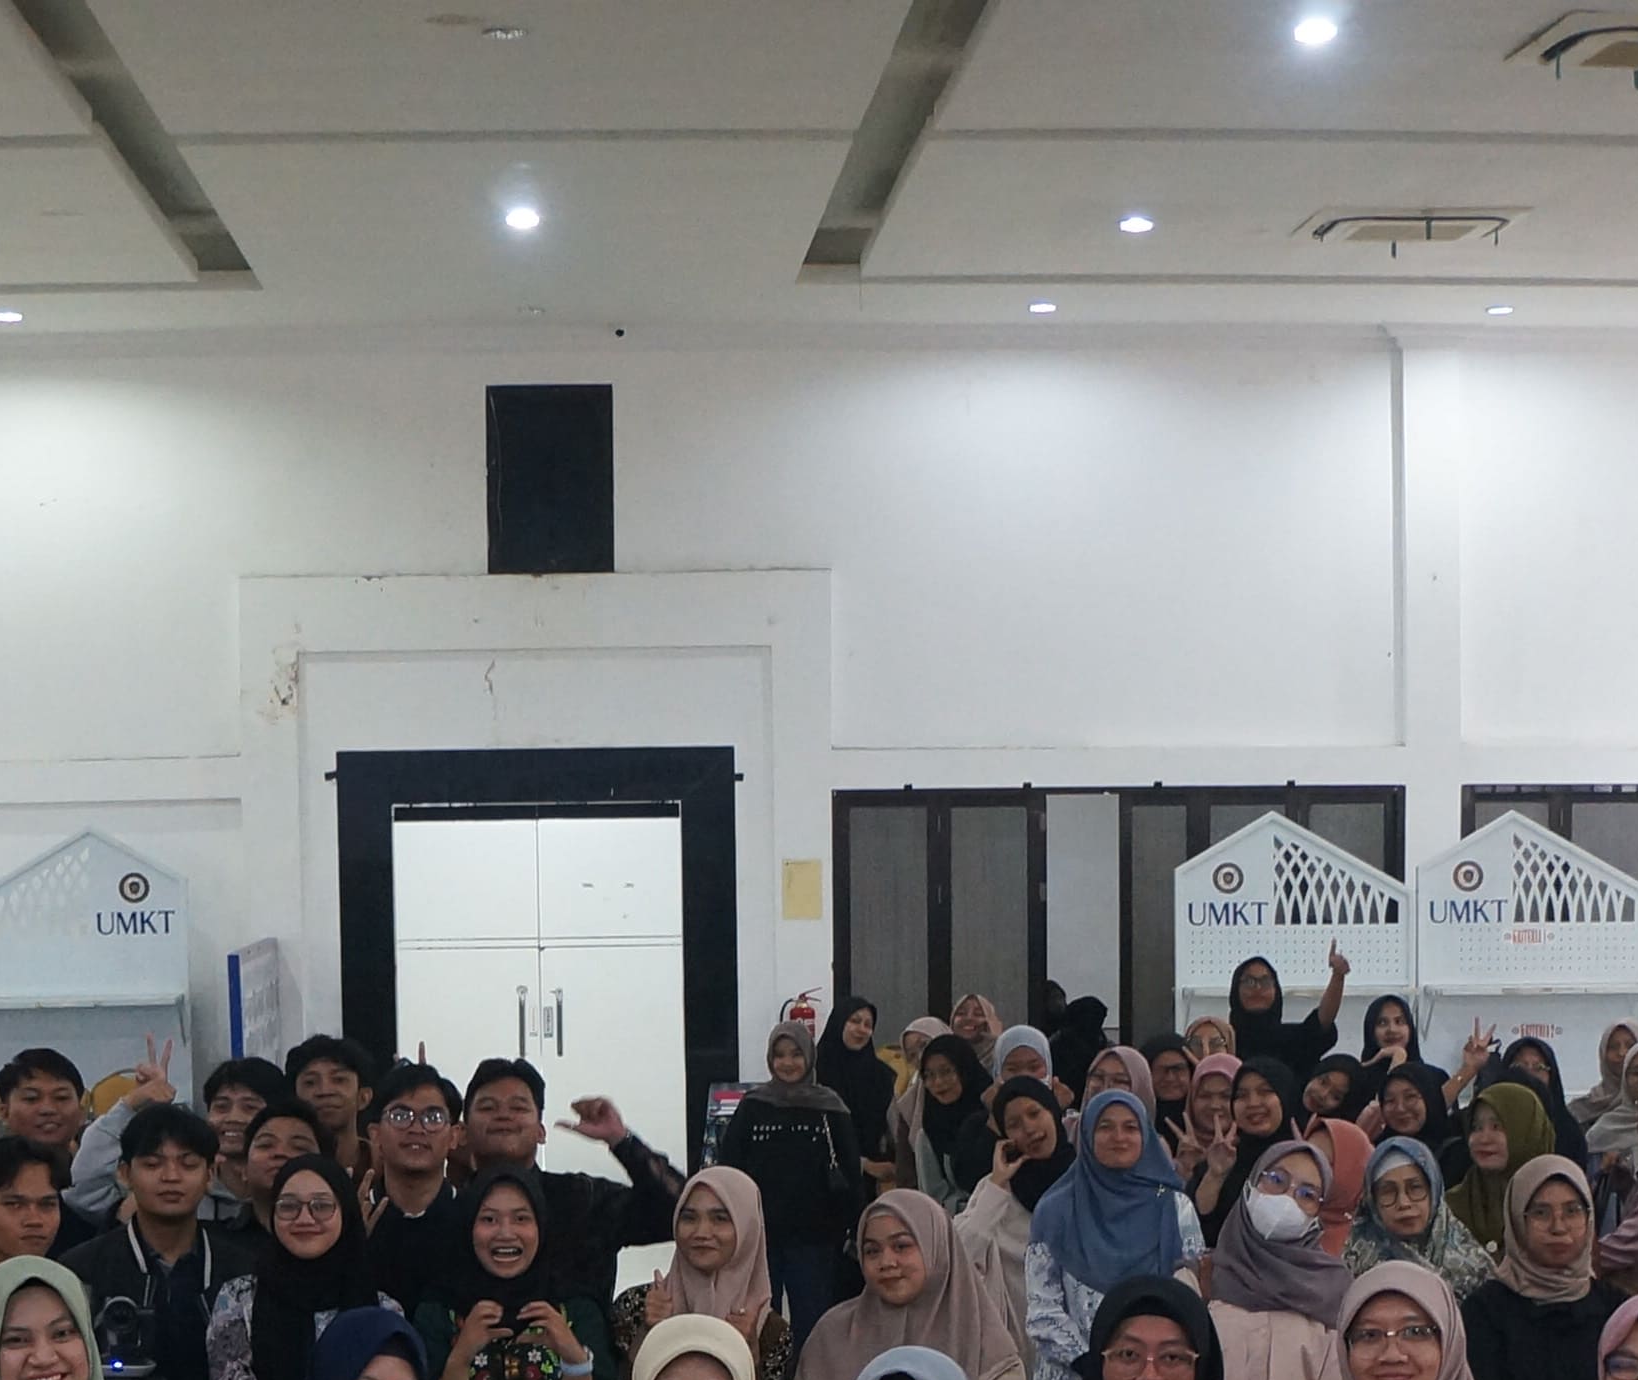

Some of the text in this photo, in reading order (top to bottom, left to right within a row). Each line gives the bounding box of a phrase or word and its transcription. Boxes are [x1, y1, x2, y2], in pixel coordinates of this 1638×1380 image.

[96, 910, 175, 935] UMKT
[1188, 902, 1269, 926] UMKT
[1429, 899, 1507, 924] UMKT
